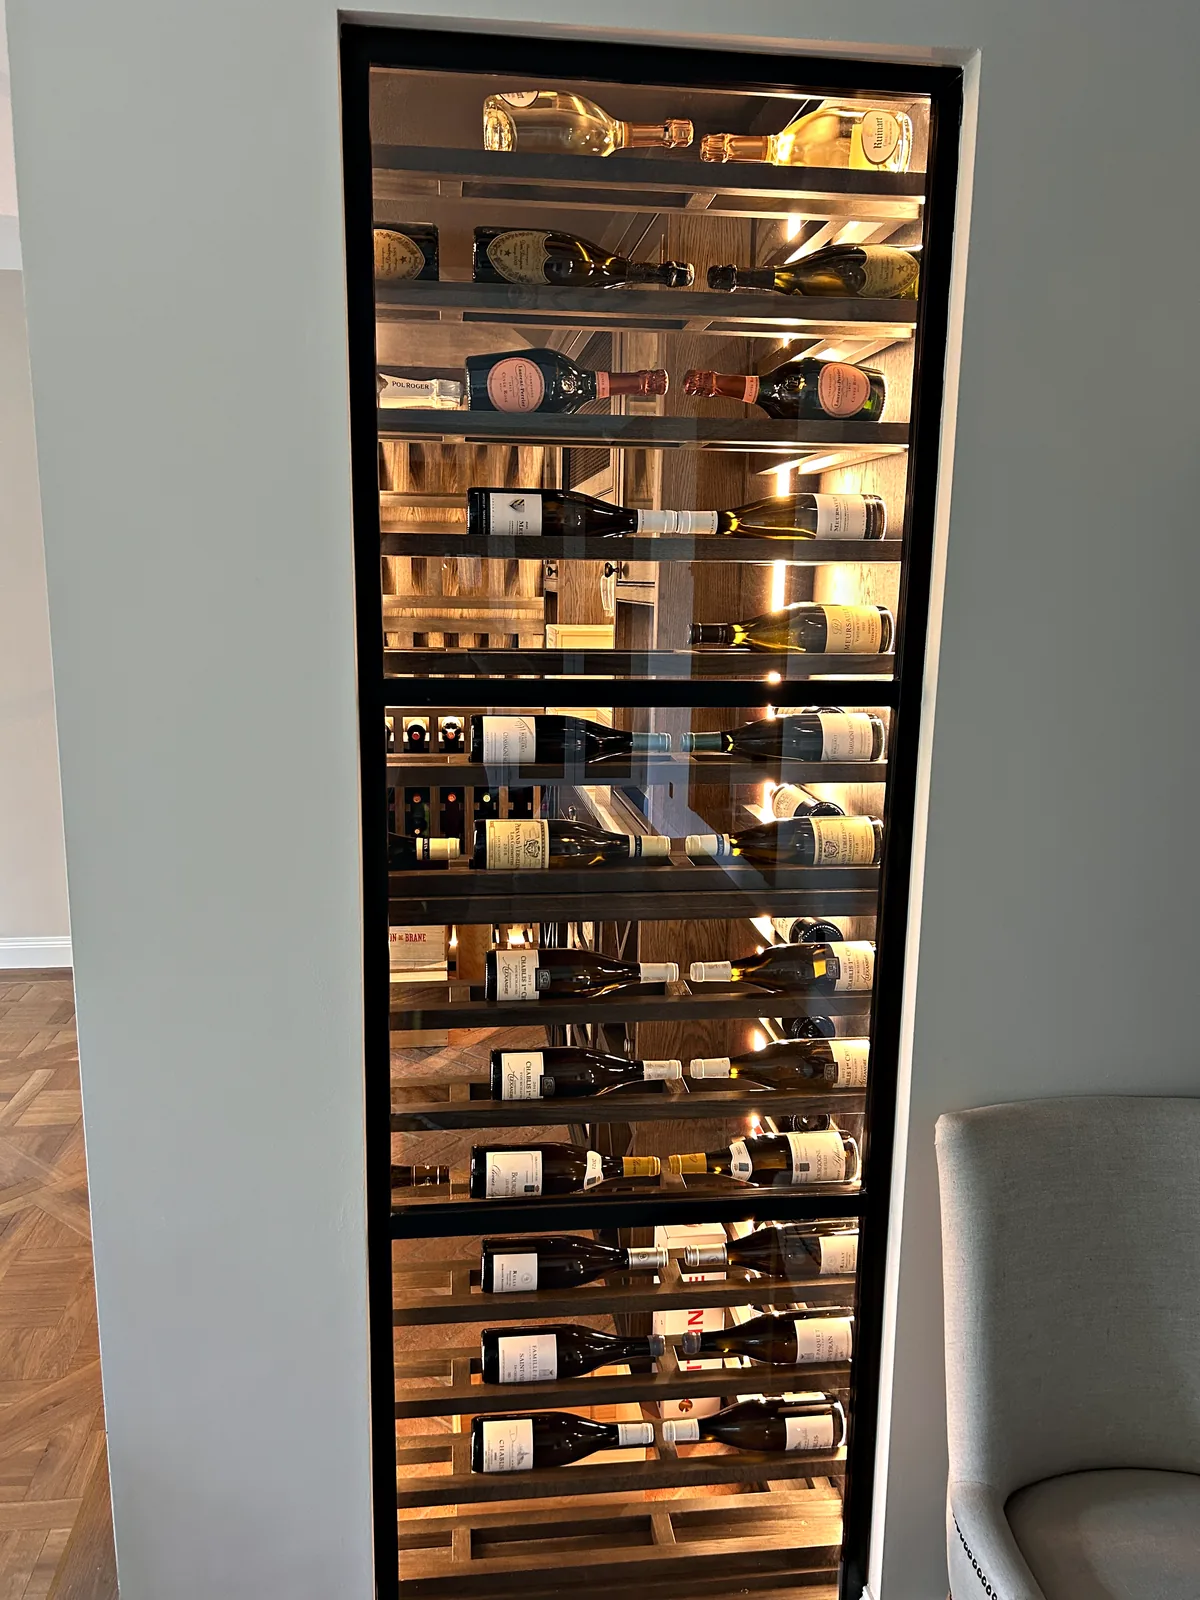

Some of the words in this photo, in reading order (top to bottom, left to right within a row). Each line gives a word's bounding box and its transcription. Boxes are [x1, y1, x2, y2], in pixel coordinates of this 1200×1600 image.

[873, 117, 883, 149] Ruinart
[392, 381, 405, 389] POL
[406, 382, 430, 390] ROGER
[518, 365, 526, 408] Laurent-Perrier
[844, 609, 852, 651] MEURSAULT
[405, 933, 427, 942] BRANE
[846, 963, 854, 991] CHABLIS
